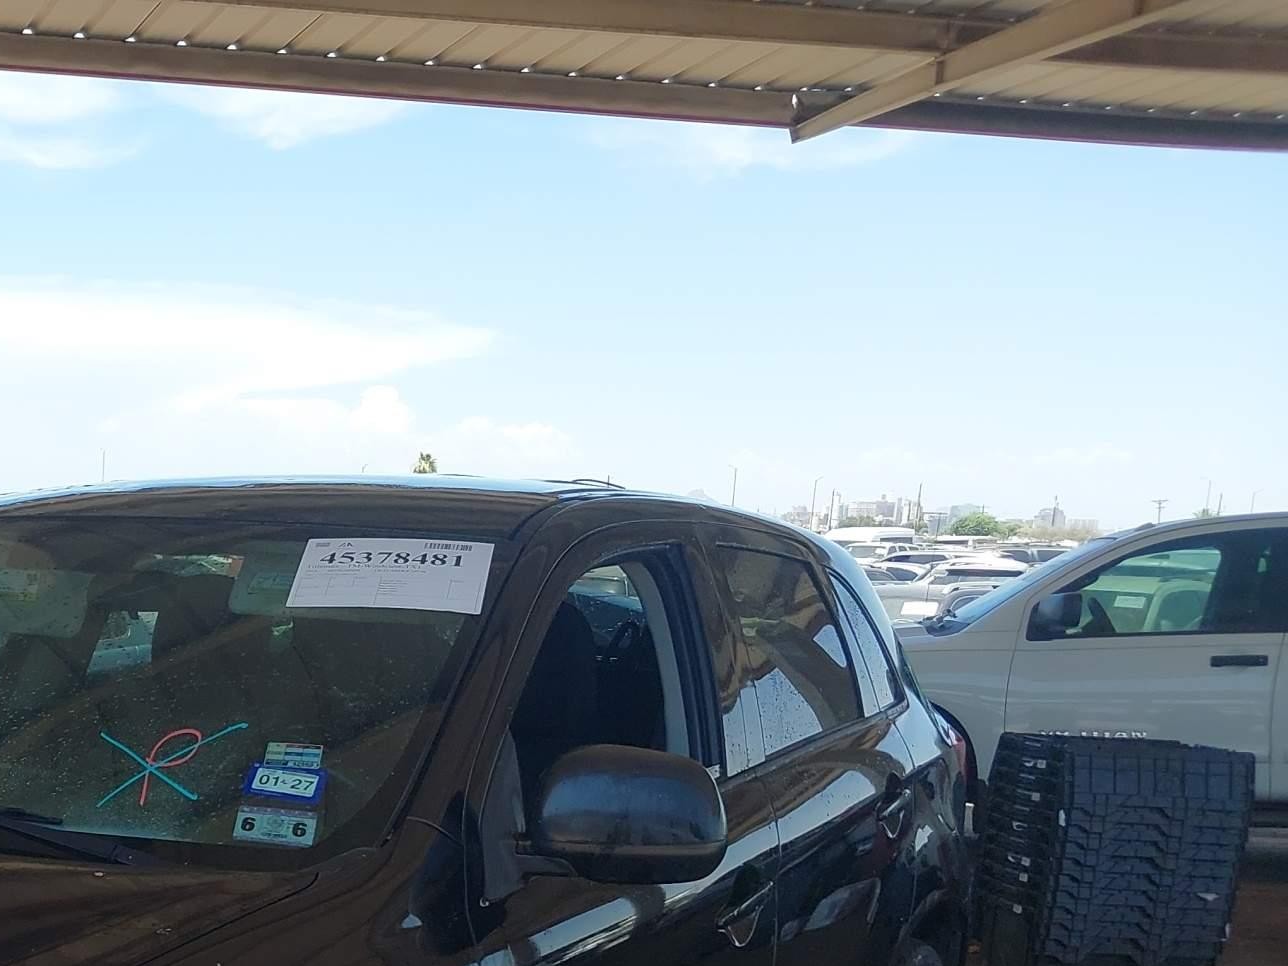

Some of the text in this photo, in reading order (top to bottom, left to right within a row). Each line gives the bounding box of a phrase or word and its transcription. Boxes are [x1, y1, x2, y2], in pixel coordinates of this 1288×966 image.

[319, 551, 464, 568] 45378481
[240, 816, 257, 832] 6
[292, 822, 308, 838] 6
